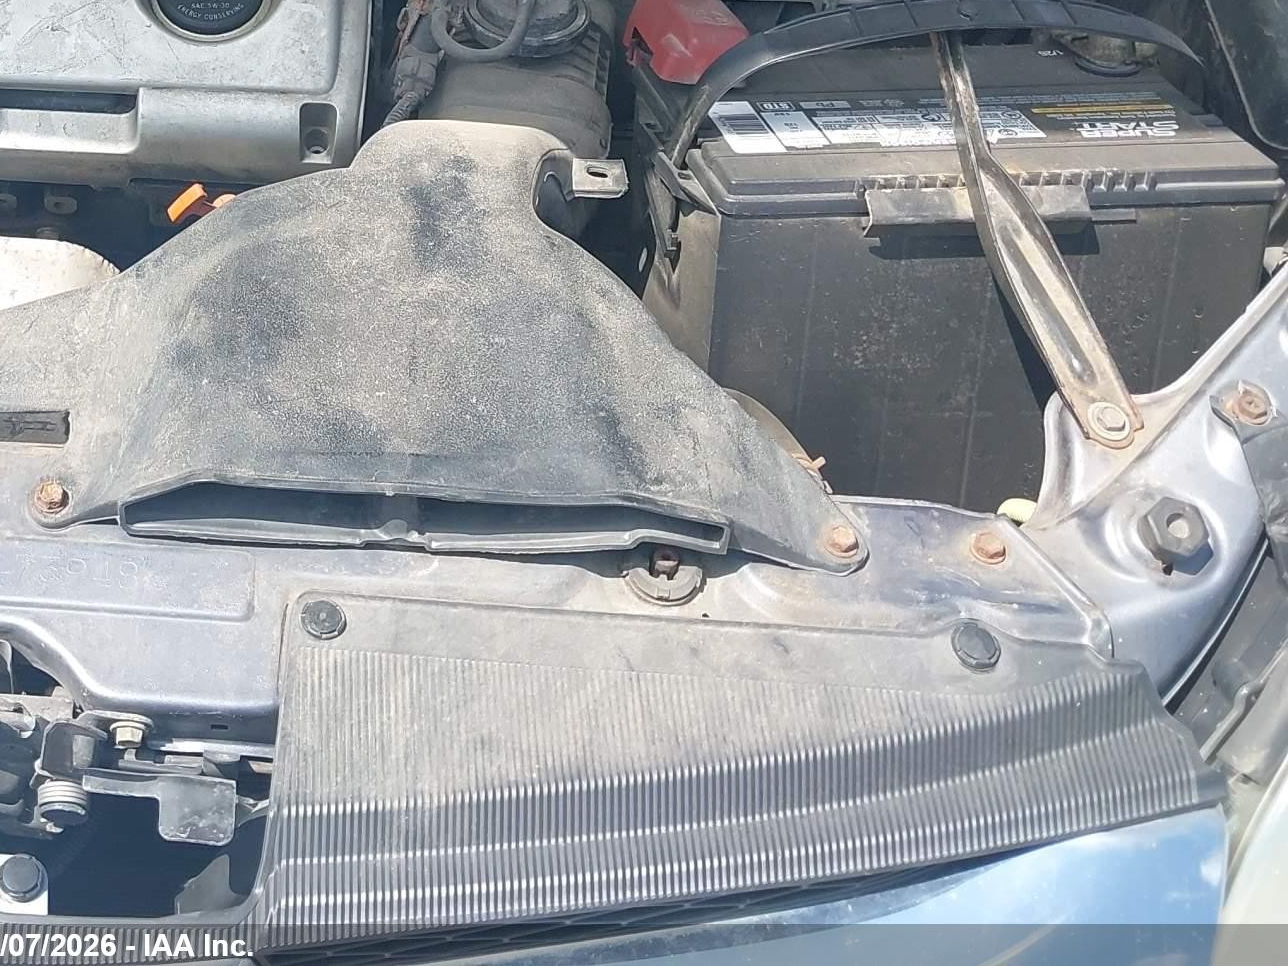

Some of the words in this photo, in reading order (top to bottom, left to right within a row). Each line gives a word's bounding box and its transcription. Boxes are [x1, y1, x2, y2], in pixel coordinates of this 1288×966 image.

[177, 4, 202, 18] ENERGY
[204, 2, 245, 20] CONSERVING
[1076, 120, 1180, 131] START
[1078, 130, 1177, 138] SUPER
